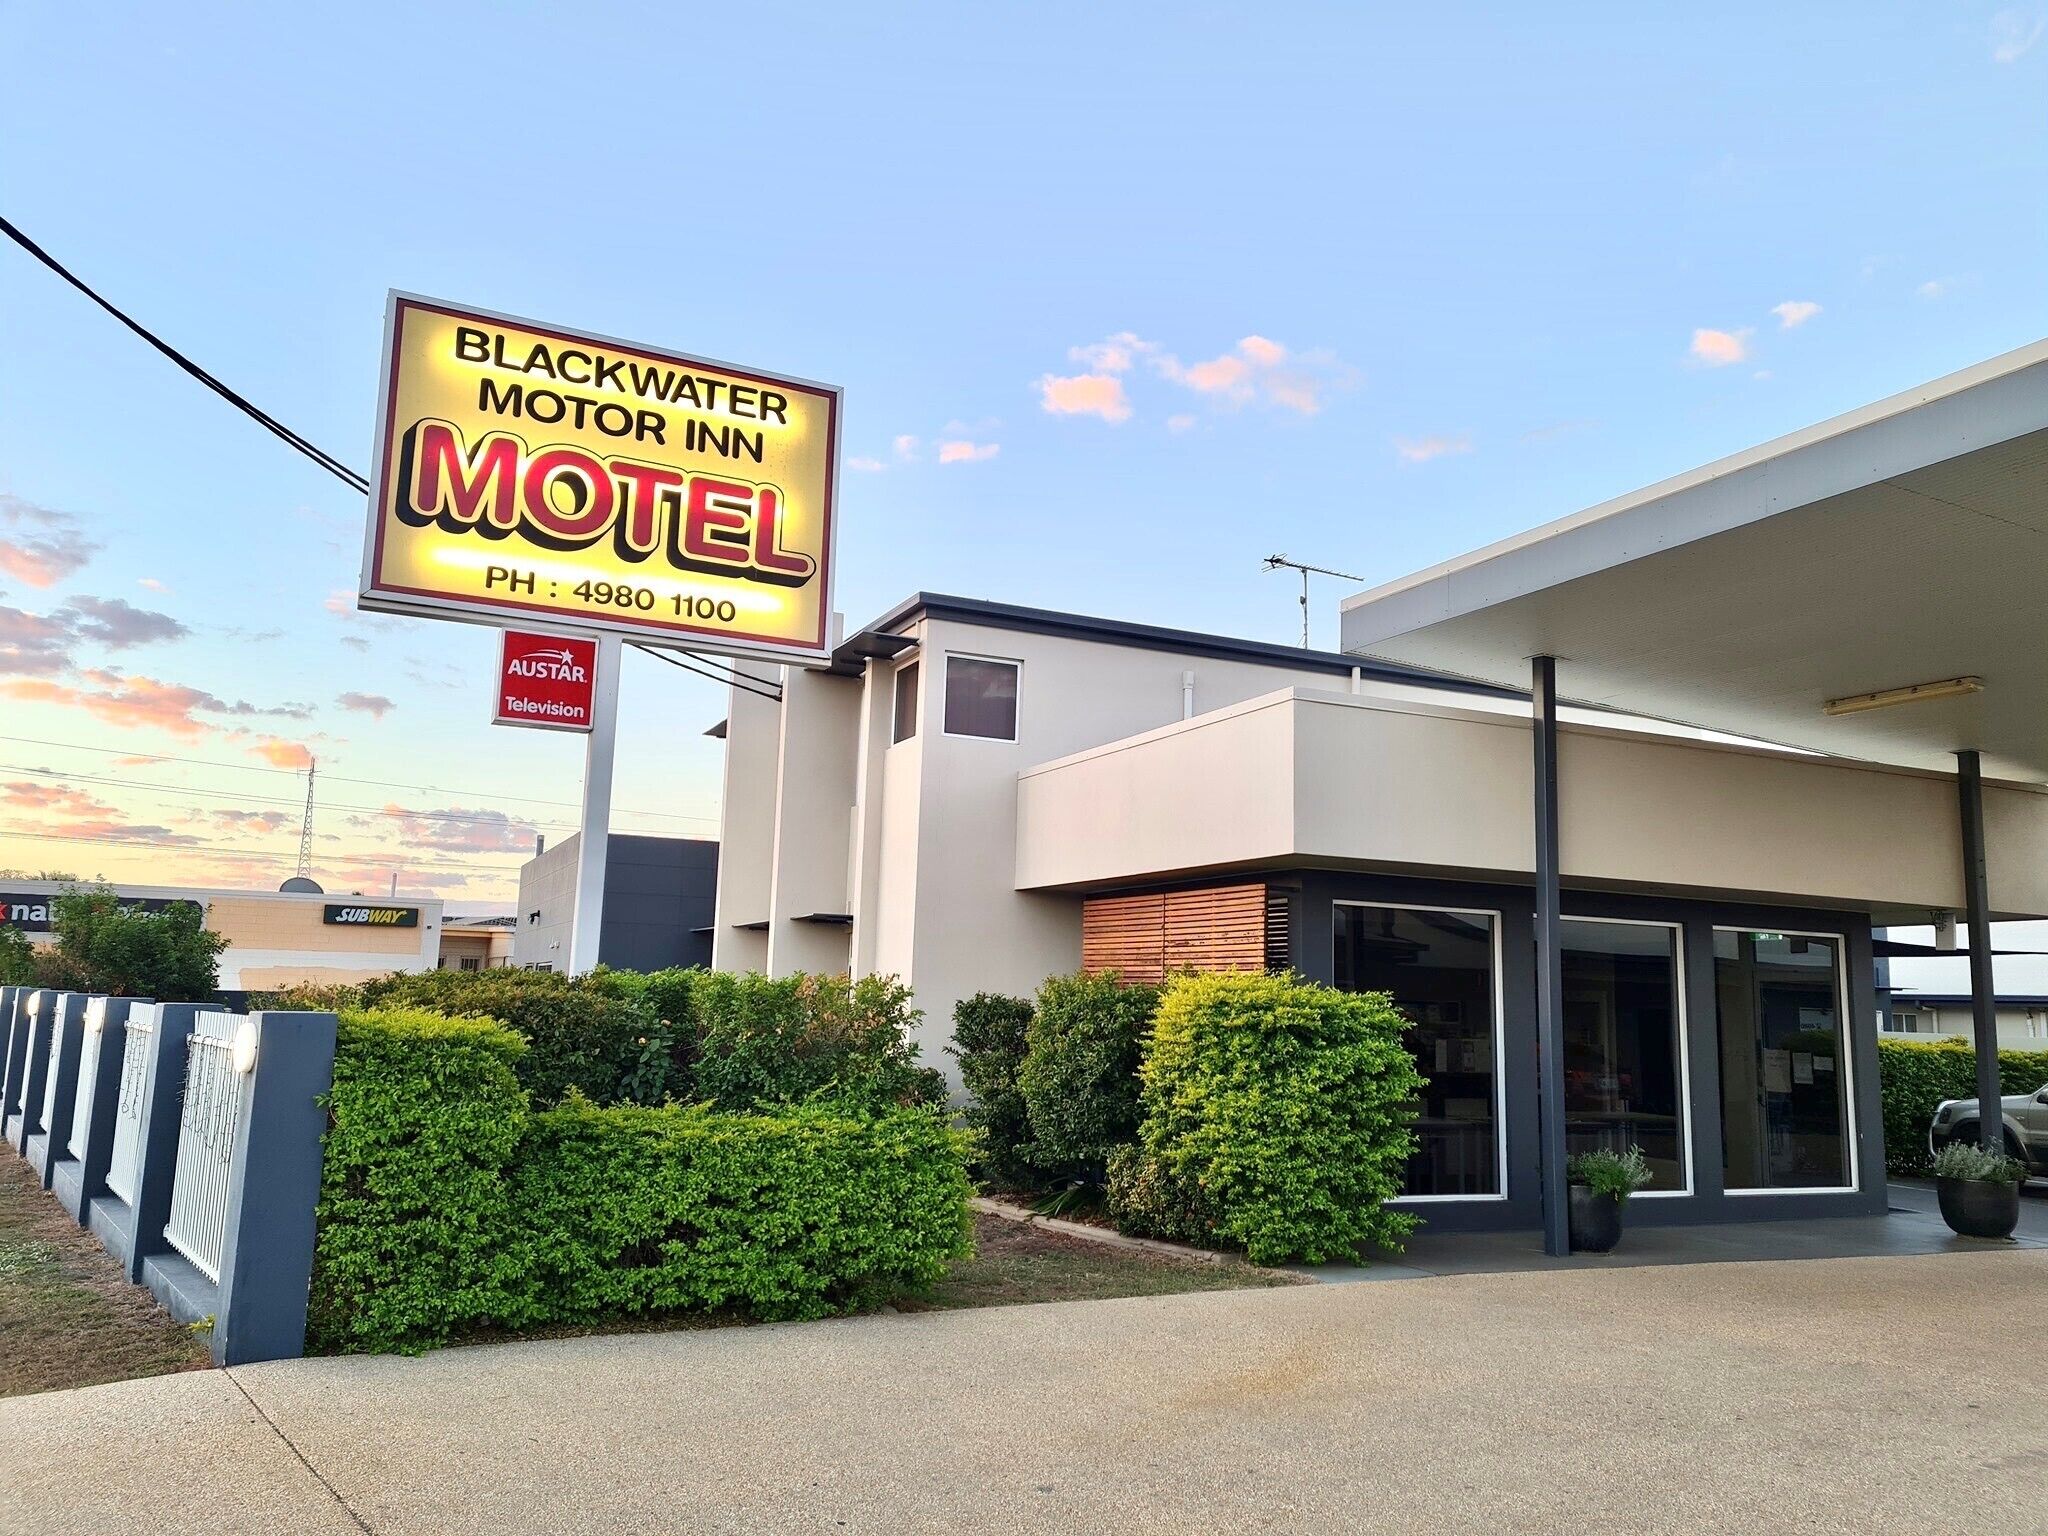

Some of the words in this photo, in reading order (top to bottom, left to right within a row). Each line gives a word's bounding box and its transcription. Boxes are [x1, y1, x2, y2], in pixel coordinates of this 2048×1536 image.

[456, 326, 787, 424] BLACKWATER
[478, 378, 666, 445] MOTOR
[685, 418, 763, 463] INN
[396, 418, 816, 587] MOTEL
[485, 565, 535, 595] PH
[572, 579, 655, 611] 4980
[670, 593, 736, 622] 1100
[507, 658, 586, 683] AUSTAR
[505, 696, 584, 718] Television
[335, 908, 407, 924] SUBWAY
